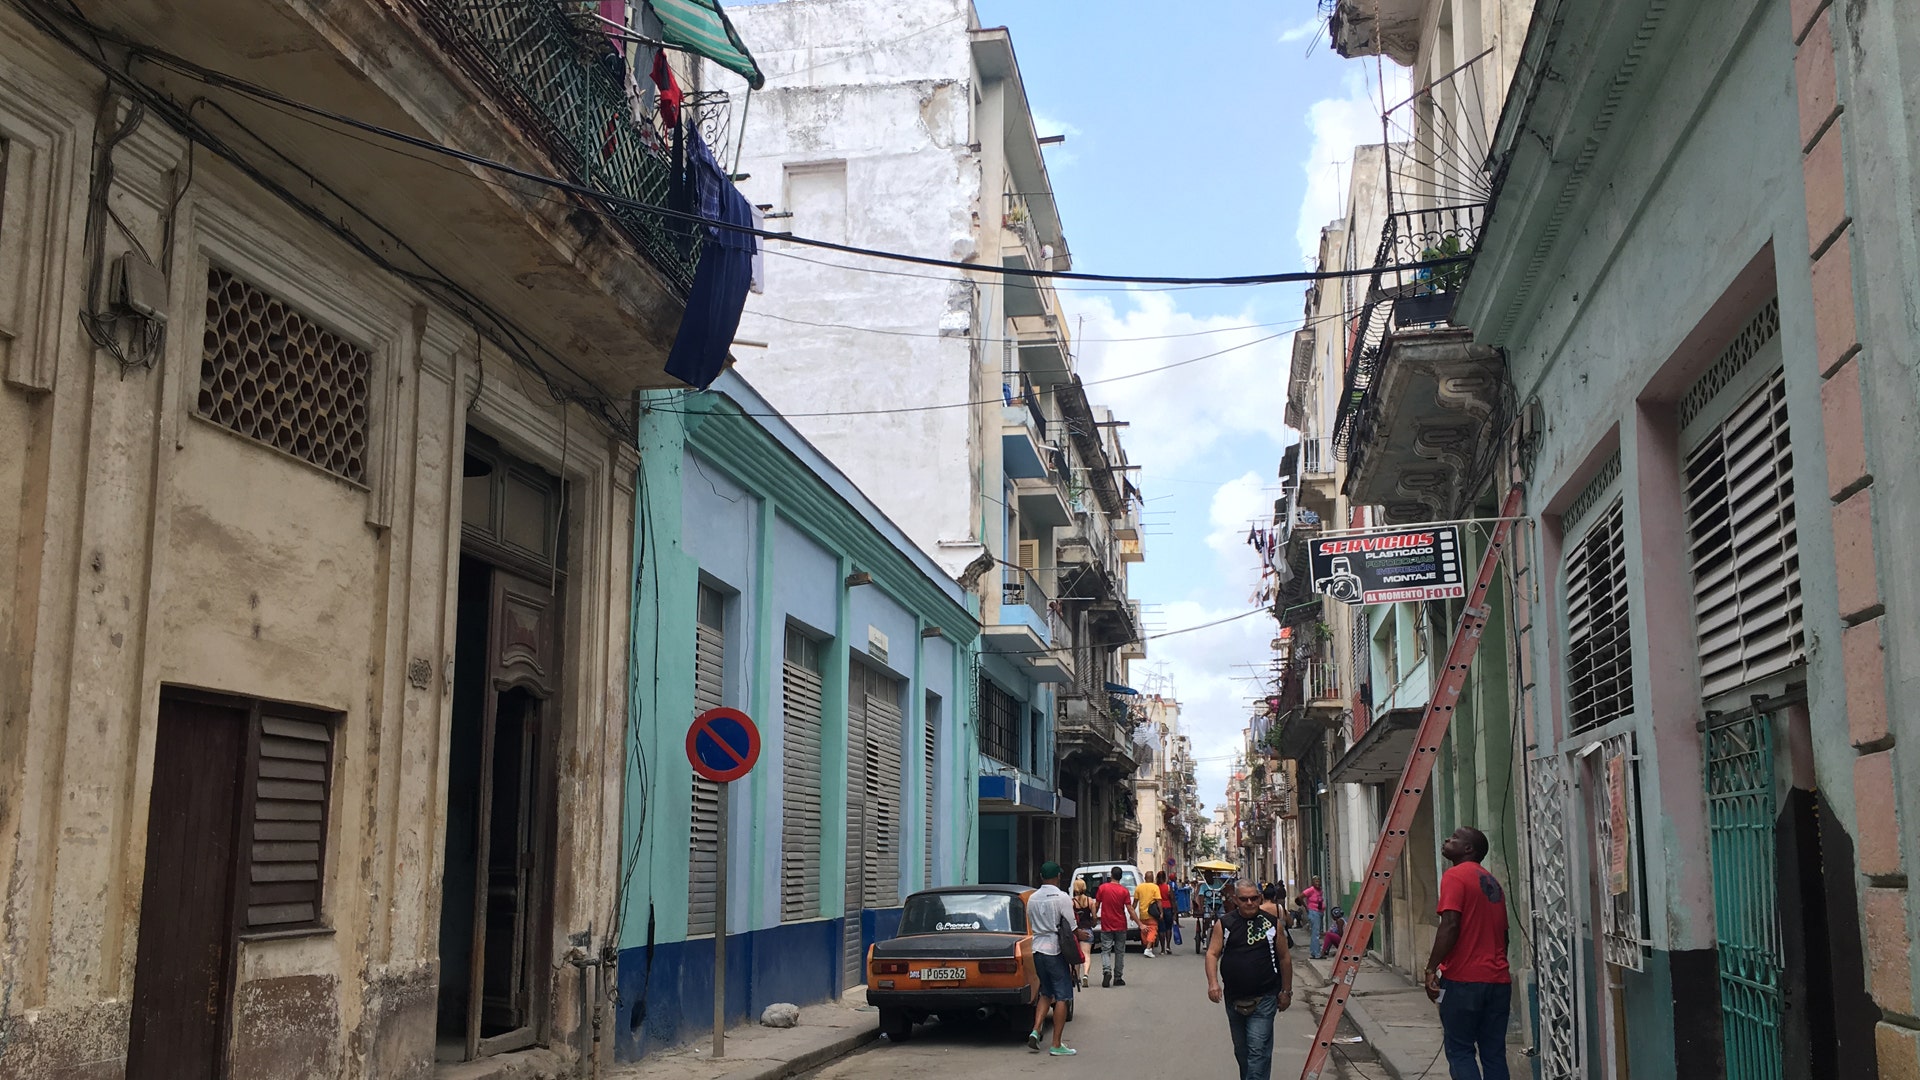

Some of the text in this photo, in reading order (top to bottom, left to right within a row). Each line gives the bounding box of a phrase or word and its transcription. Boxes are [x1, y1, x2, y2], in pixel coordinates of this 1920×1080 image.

[1319, 532, 1435, 556] SERVICIOS
[1365, 547, 1434, 560] PLASTICADO
[1383, 572, 1437, 583] MONTAJE
[1366, 586, 1463, 602] AL MOMENTO FOTO
